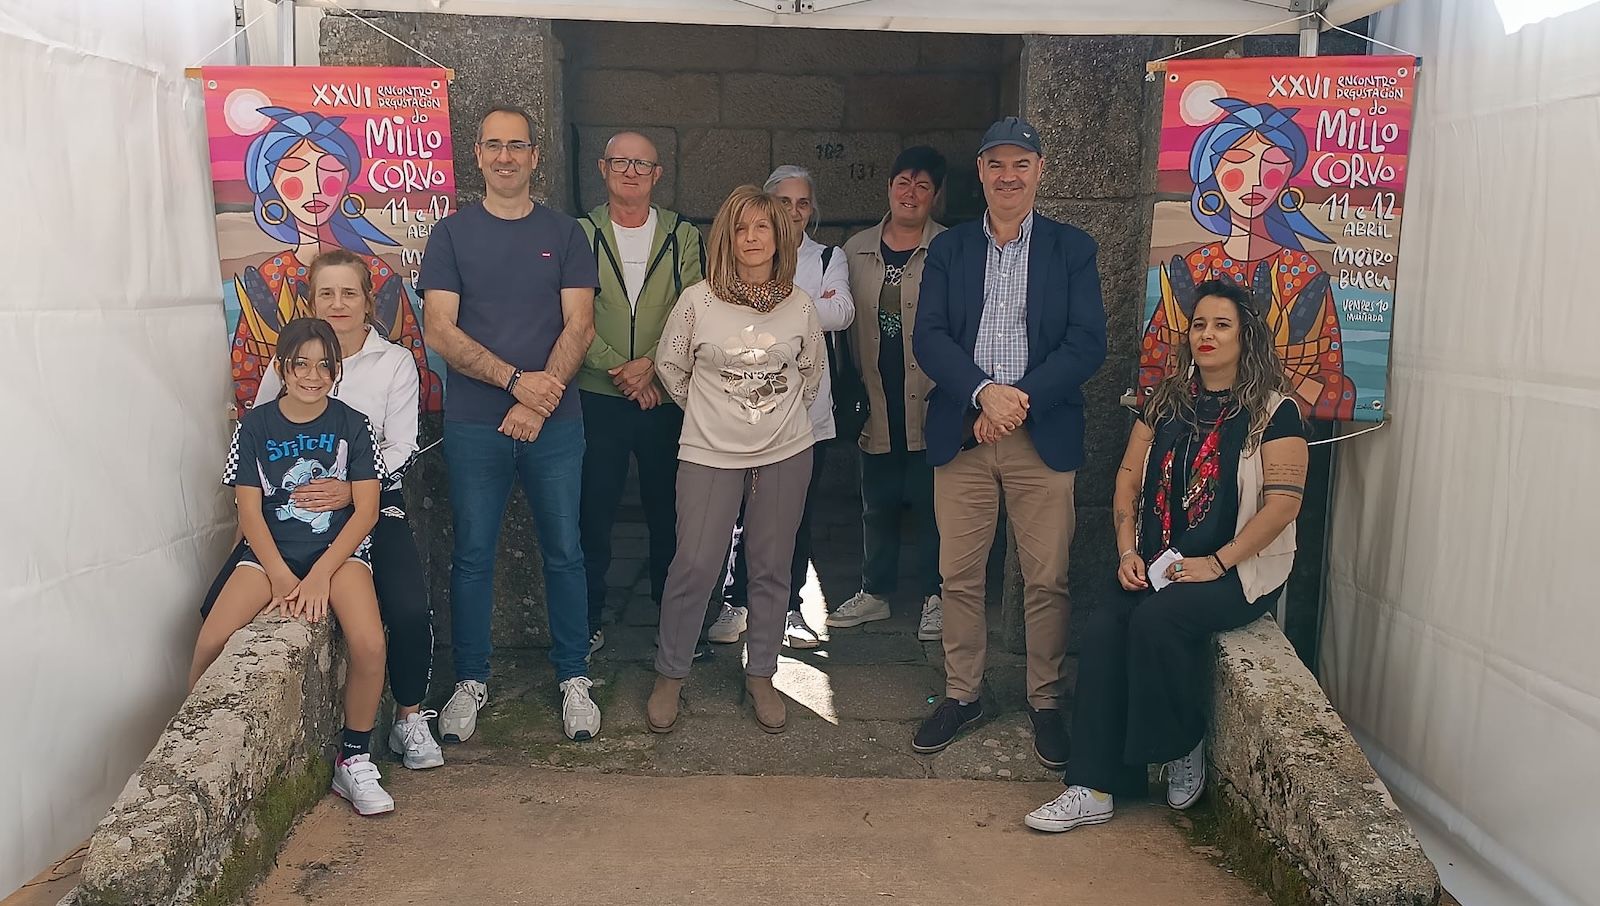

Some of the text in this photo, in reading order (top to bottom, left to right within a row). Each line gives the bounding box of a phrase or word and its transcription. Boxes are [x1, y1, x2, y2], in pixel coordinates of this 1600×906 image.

[312, 83, 371, 107] XXVI
[1267, 73, 1331, 99] XXVI
[411, 108, 428, 123] do
[1368, 99, 1387, 116] do
[365, 115, 442, 159] MILLO
[1315, 107, 1399, 153] MILLO
[368, 159, 446, 193] CORVO
[1311, 153, 1395, 189] CORVO
[381, 197, 408, 225] 11
[415, 209, 426, 222] e
[1319, 192, 1396, 221] 11 e 12
[1343, 221, 1392, 238] ABRIL
[1375, 299, 1389, 313] 10
